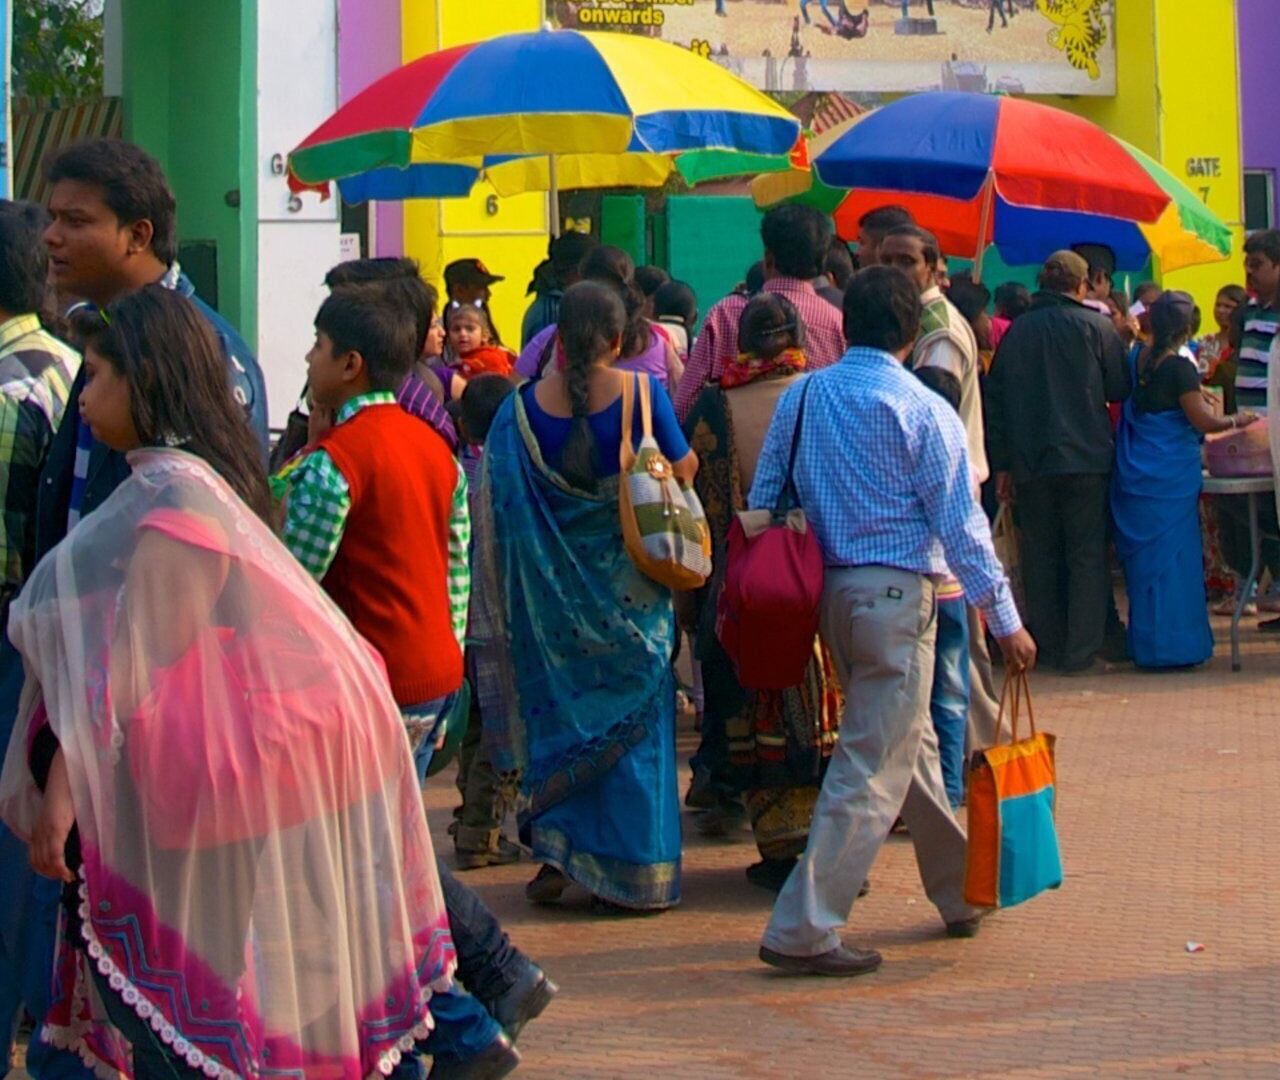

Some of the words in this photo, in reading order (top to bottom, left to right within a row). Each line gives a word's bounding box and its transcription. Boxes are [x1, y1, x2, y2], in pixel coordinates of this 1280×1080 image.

[578, 7, 665, 26] onwards
[1185, 157, 1221, 178] GATE
[485, 194, 499, 216] 6
[1198, 186, 1210, 204] 7
